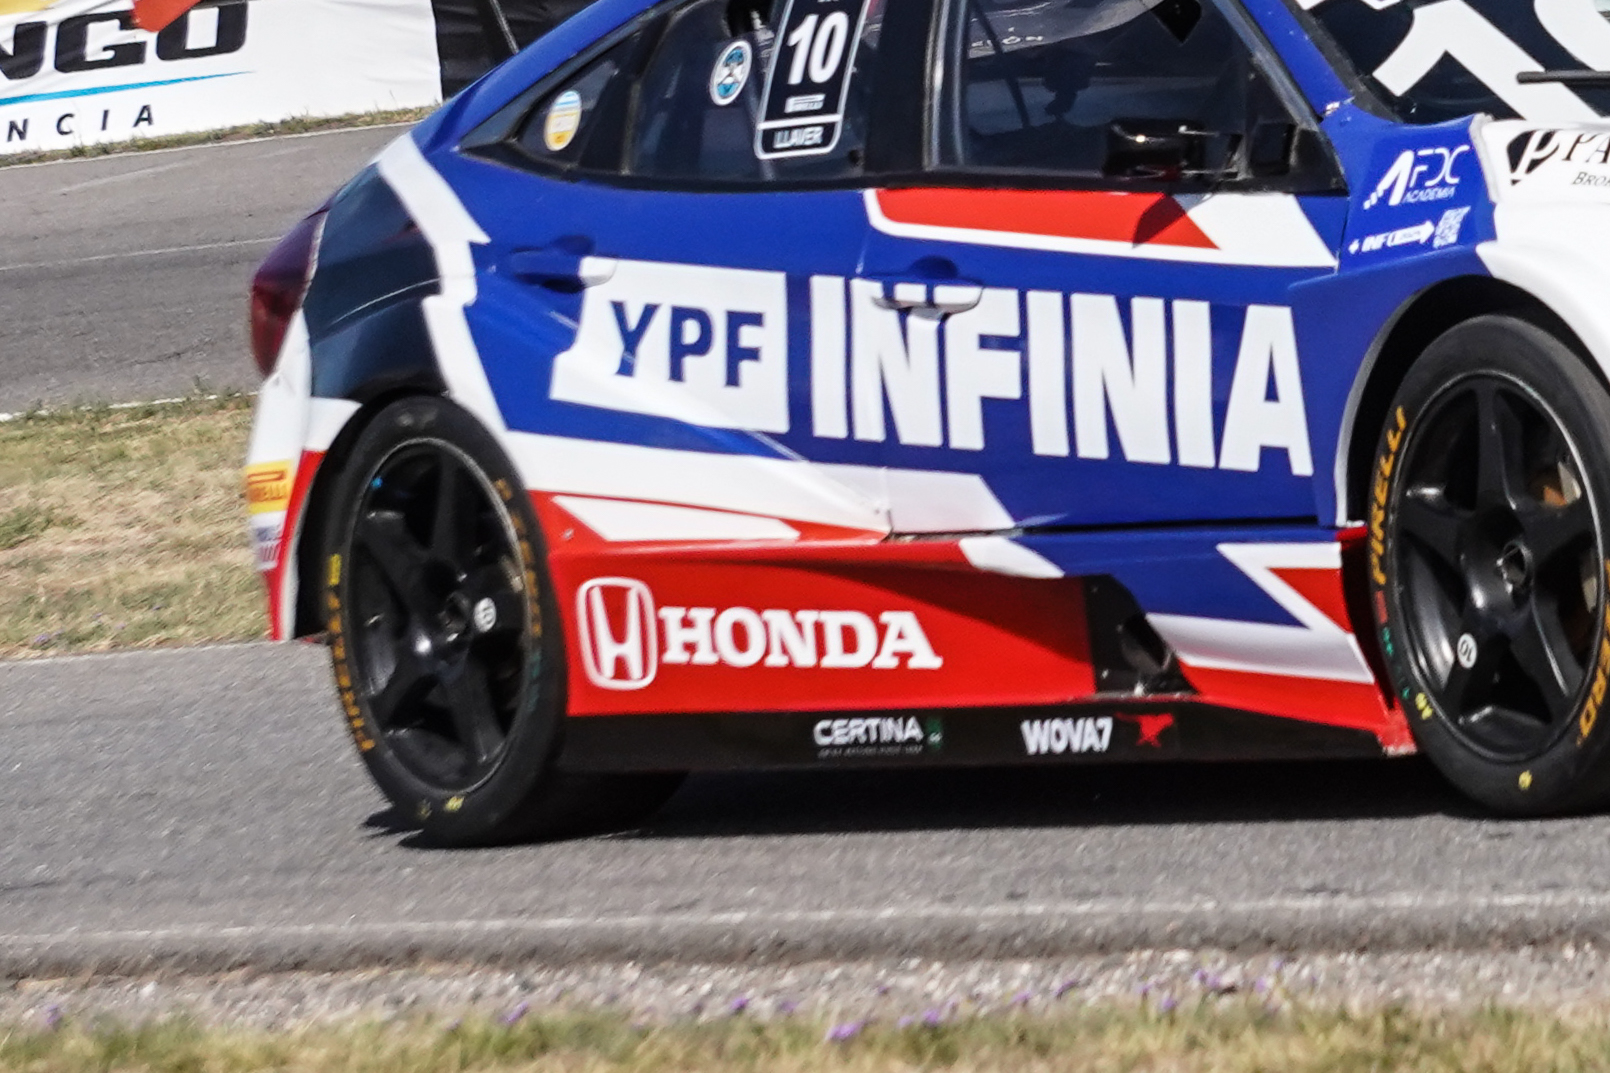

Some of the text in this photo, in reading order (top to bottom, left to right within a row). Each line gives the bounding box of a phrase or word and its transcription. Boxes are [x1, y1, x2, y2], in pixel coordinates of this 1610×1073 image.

[787, 11, 850, 86] 10
[611, 274, 1314, 477] YPF INFINIA
[658, 607, 944, 670] HONDA
[812, 715, 925, 746] CERTINA
